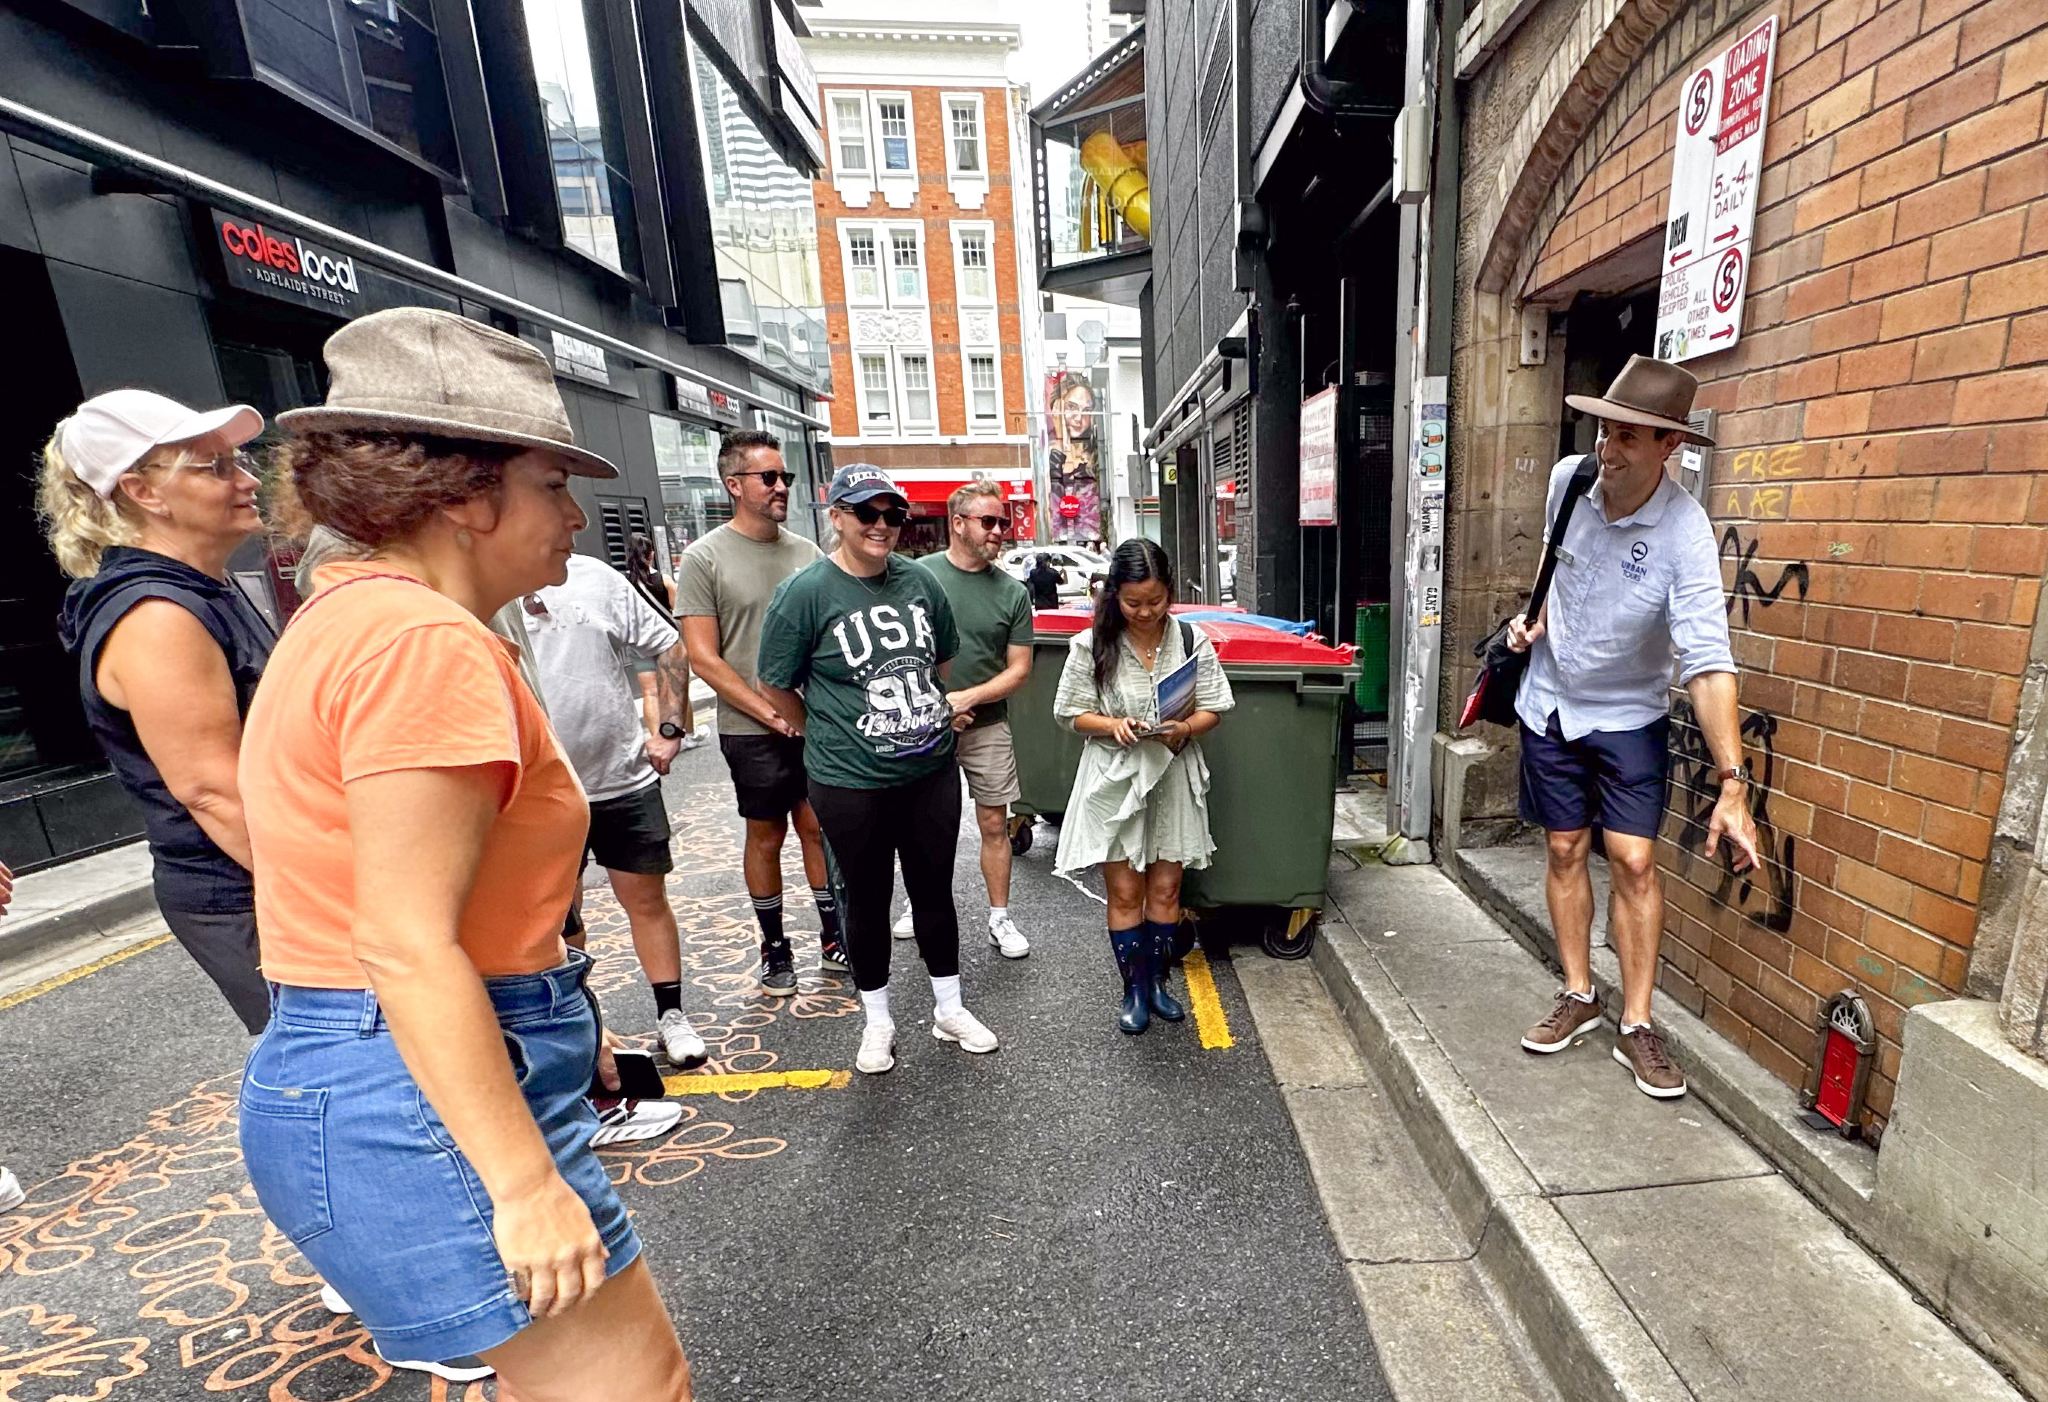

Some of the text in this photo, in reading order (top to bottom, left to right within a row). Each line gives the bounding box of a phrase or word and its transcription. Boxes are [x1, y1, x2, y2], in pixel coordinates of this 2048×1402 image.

[1727, 25, 1770, 79] LOADING
[1727, 64, 1760, 110] ZONE
[1744, 115, 1760, 137] MAX
[1715, 186, 1747, 219] DAILY
[222, 222, 359, 294] coles local
[256, 268, 345, 306] ADELAIDE STREET
[1665, 268, 1687, 288] POLICE
[1661, 282, 1689, 303] VEHICLES
[1693, 289, 1707, 305] ALL
[1658, 297, 1688, 318] EXCEPTED
[1687, 305, 1710, 324] OTHER
[1687, 324, 1707, 341] TIMES
[1733, 445, 1804, 480] FREE
[1621, 560, 1647, 576] URBAN
[1623, 569, 1642, 581] TOURS
[832, 604, 937, 668] USA
[865, 666, 941, 721] 94
